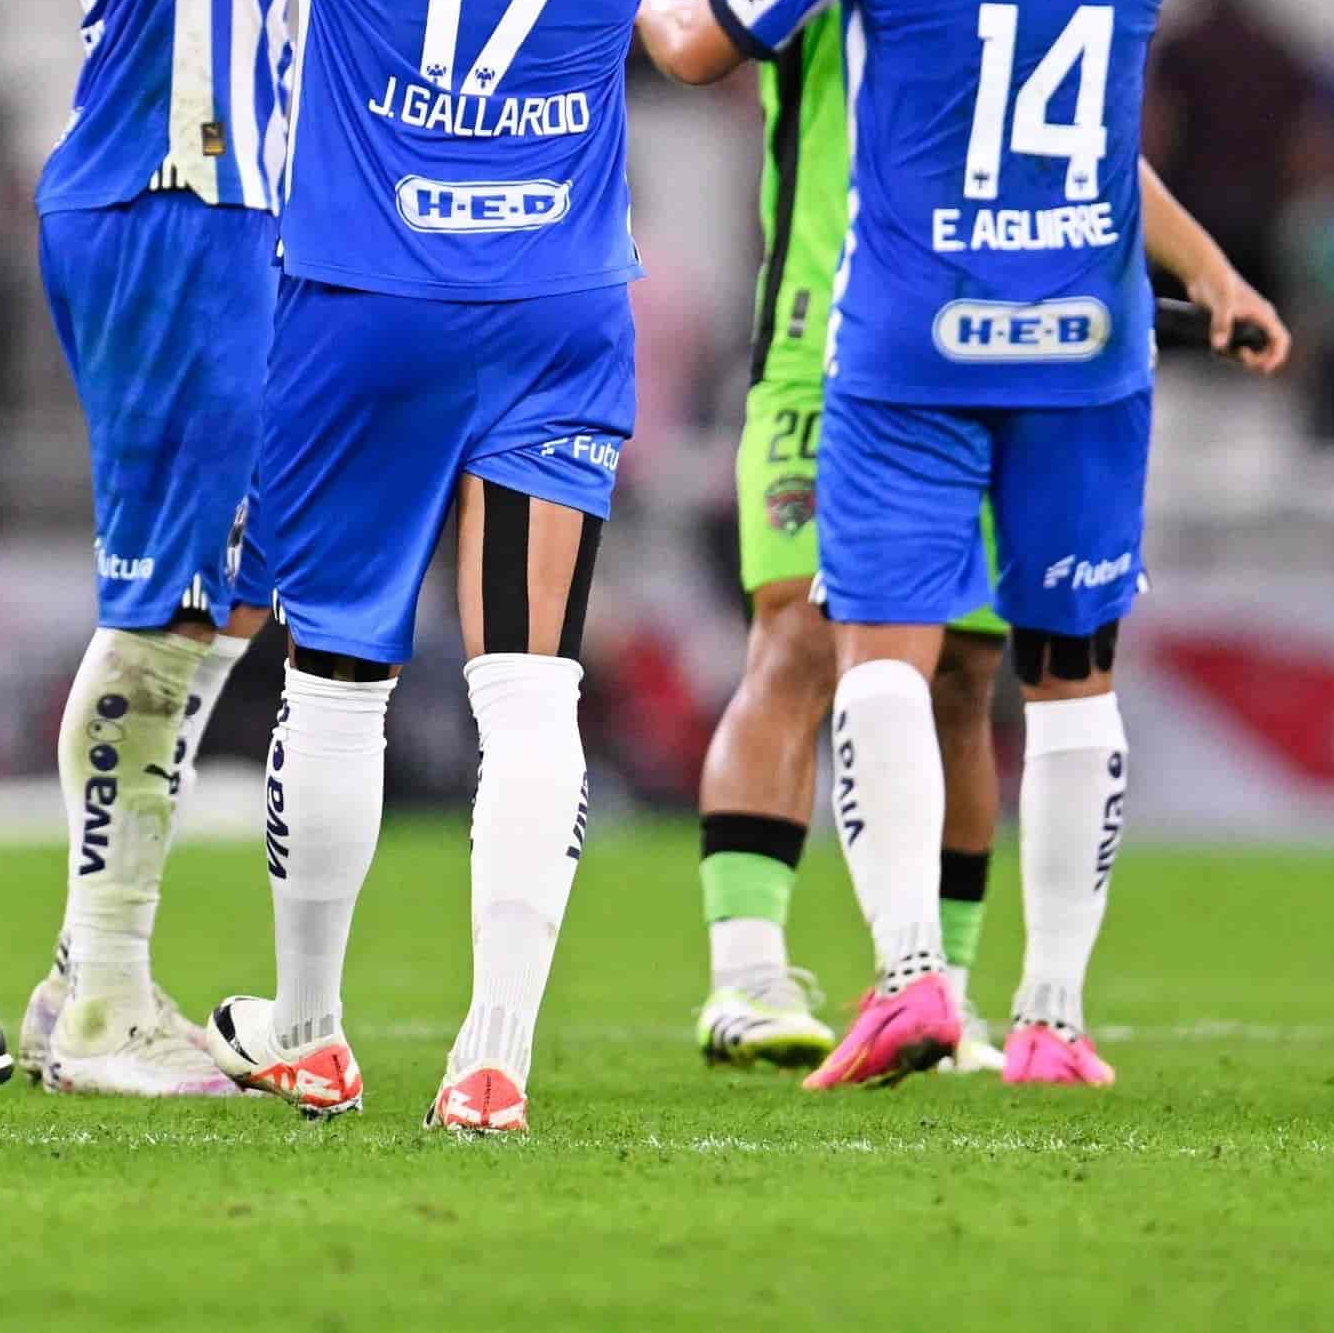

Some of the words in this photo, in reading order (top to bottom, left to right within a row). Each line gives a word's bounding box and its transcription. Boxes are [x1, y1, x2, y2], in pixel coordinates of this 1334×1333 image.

[963, 2, 1115, 200] 14
[970, 202, 1120, 250] AGUIRRE
[79, 776, 119, 876] viva
